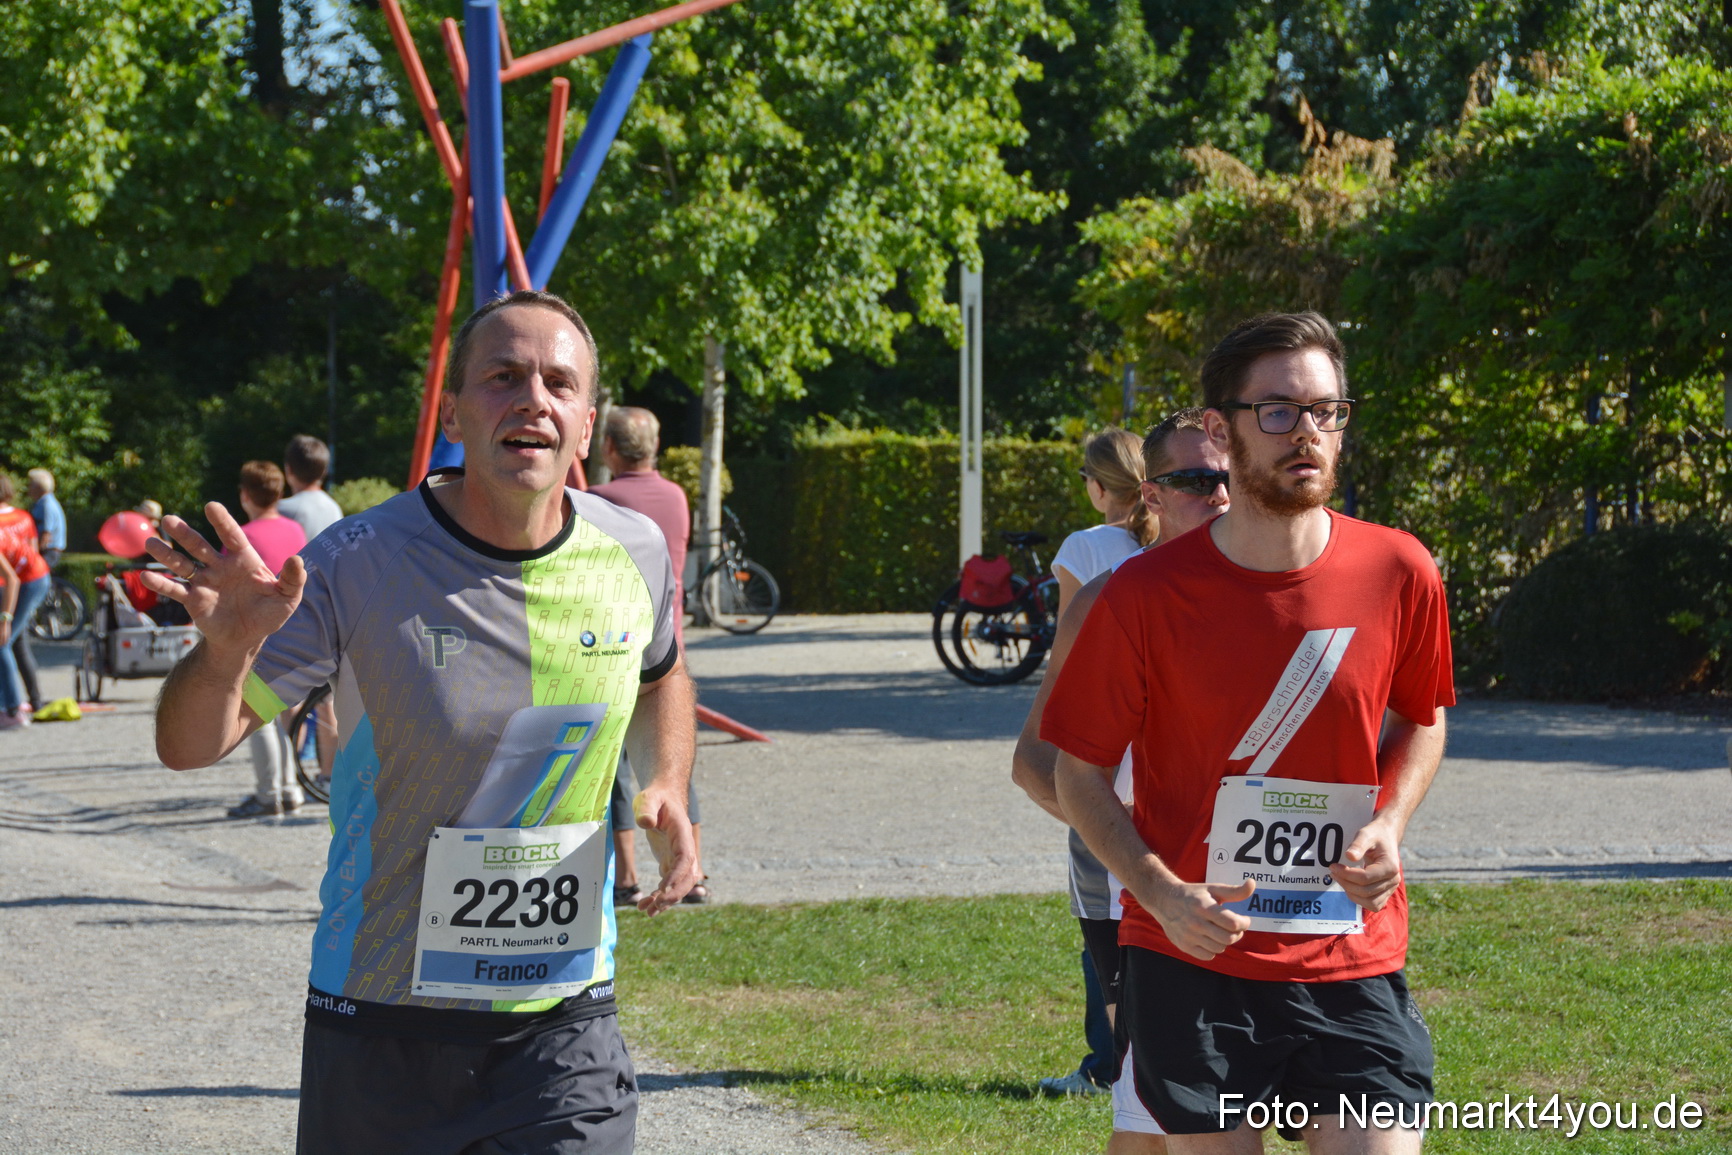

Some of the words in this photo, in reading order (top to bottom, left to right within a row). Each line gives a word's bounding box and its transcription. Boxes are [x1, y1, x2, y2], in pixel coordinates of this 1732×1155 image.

[1269, 713, 1302, 752] Menschen
[1299, 695, 1314, 713] und
[1263, 791, 1329, 809] BOCK
[1262, 807, 1283, 815] inspired
[484, 843, 560, 863] BOCK
[1234, 819, 1344, 868] 2620
[482, 863, 508, 872] inspired
[509, 863, 517, 871] by
[536, 861, 561, 869] concepts
[1243, 872, 1276, 883] PARTL
[1278, 874, 1320, 885] Neumarkt
[450, 874, 579, 928] 2238
[1247, 893, 1322, 915] Andreas
[431, 915, 438, 925] B
[460, 936, 499, 948] PARTL
[502, 936, 553, 948] Neumarkt
[474, 959, 548, 982] Franco
